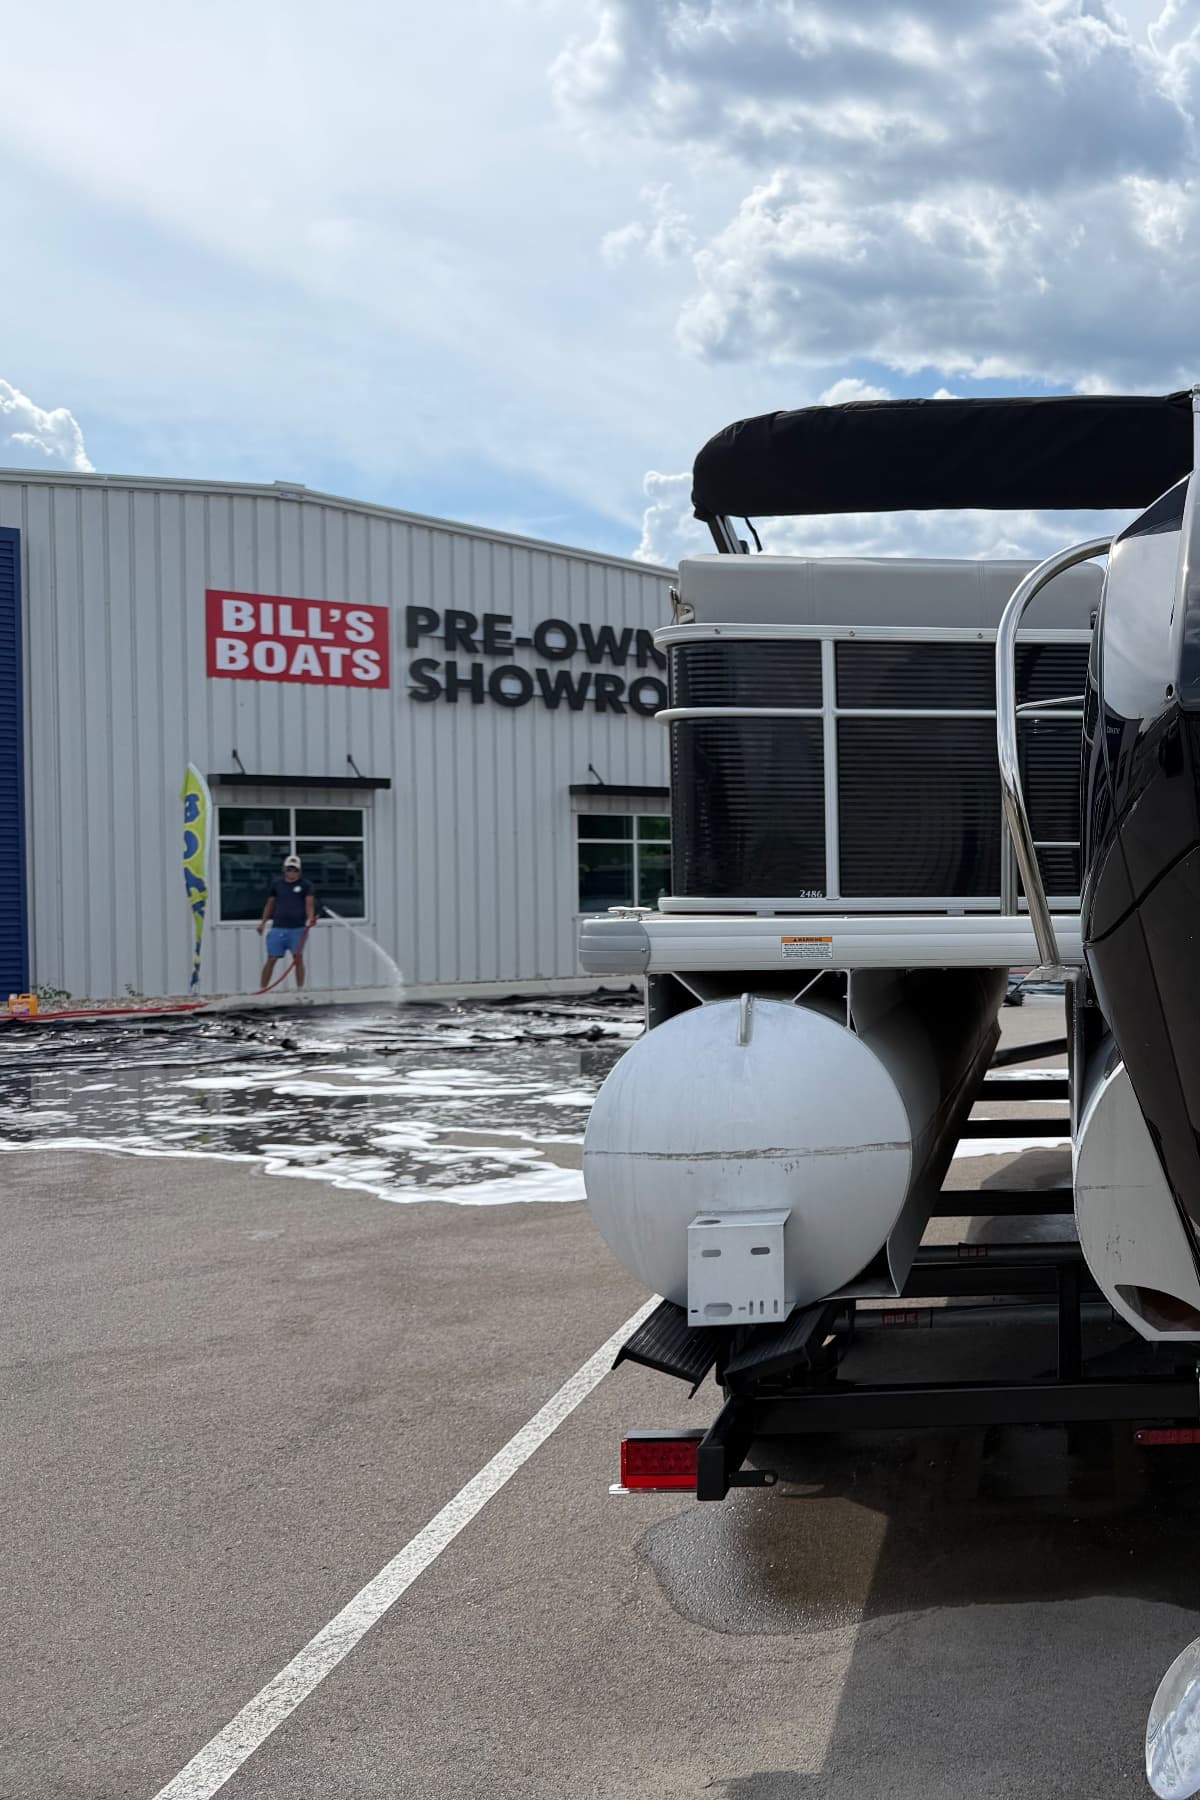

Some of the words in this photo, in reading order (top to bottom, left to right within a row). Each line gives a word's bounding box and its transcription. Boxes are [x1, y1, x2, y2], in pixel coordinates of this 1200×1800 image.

[222, 599, 375, 643] BILL'S
[215, 637, 382, 681] BOATS
[799, 889, 823, 898] 2486
